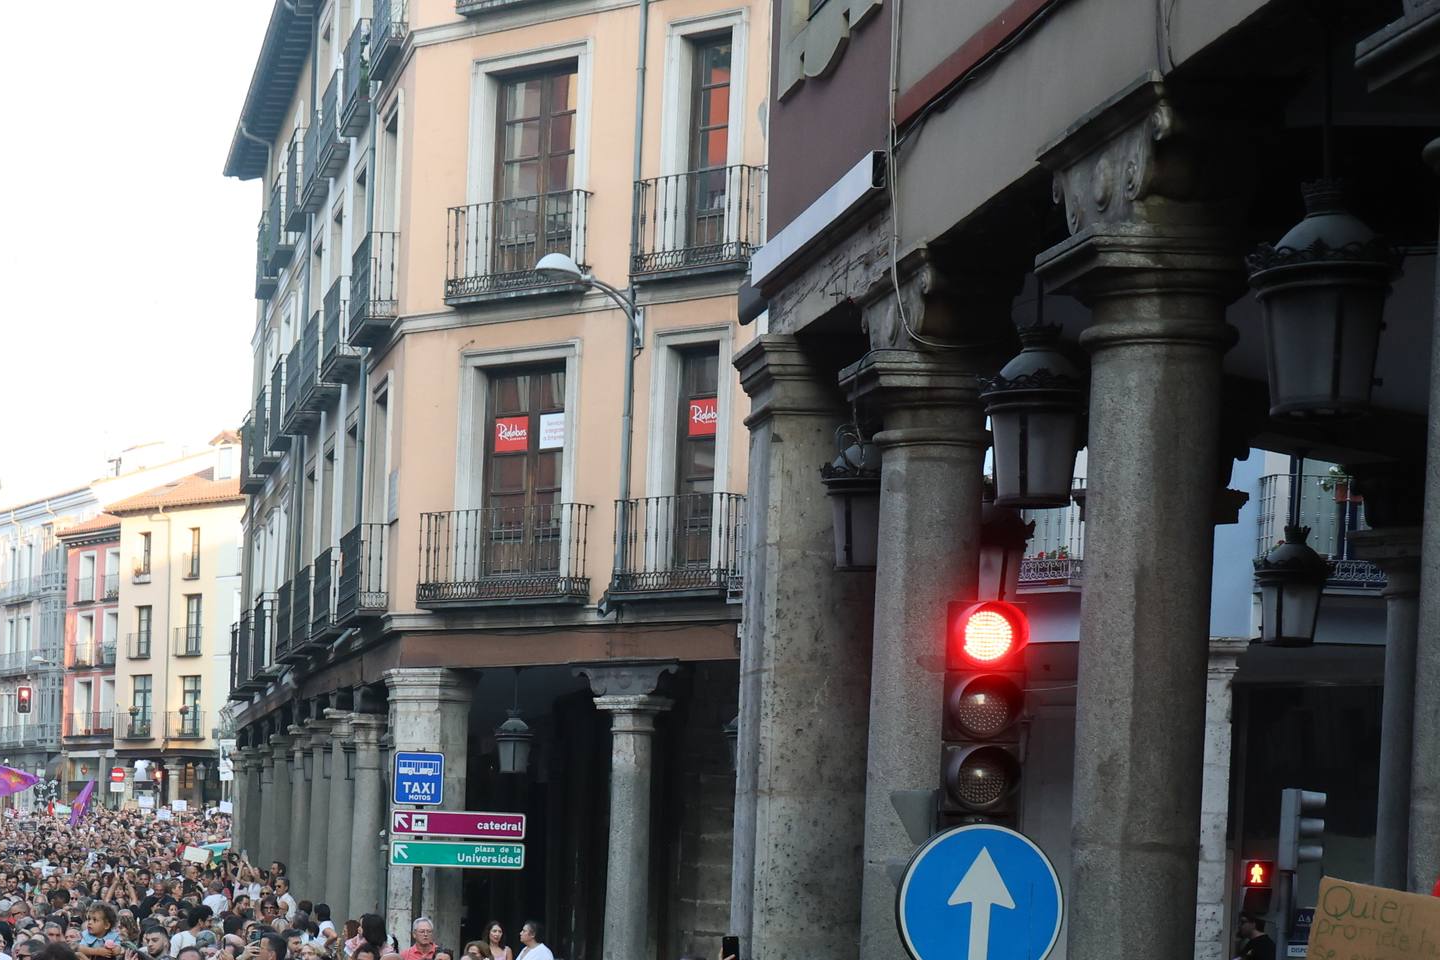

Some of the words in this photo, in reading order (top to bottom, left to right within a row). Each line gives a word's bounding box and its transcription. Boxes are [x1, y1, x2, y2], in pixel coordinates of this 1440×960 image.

[403, 782, 435, 794] TAXI
[477, 821, 522, 832] catedral
[475, 845, 495, 853] plaza
[457, 853, 521, 864] Universidad
